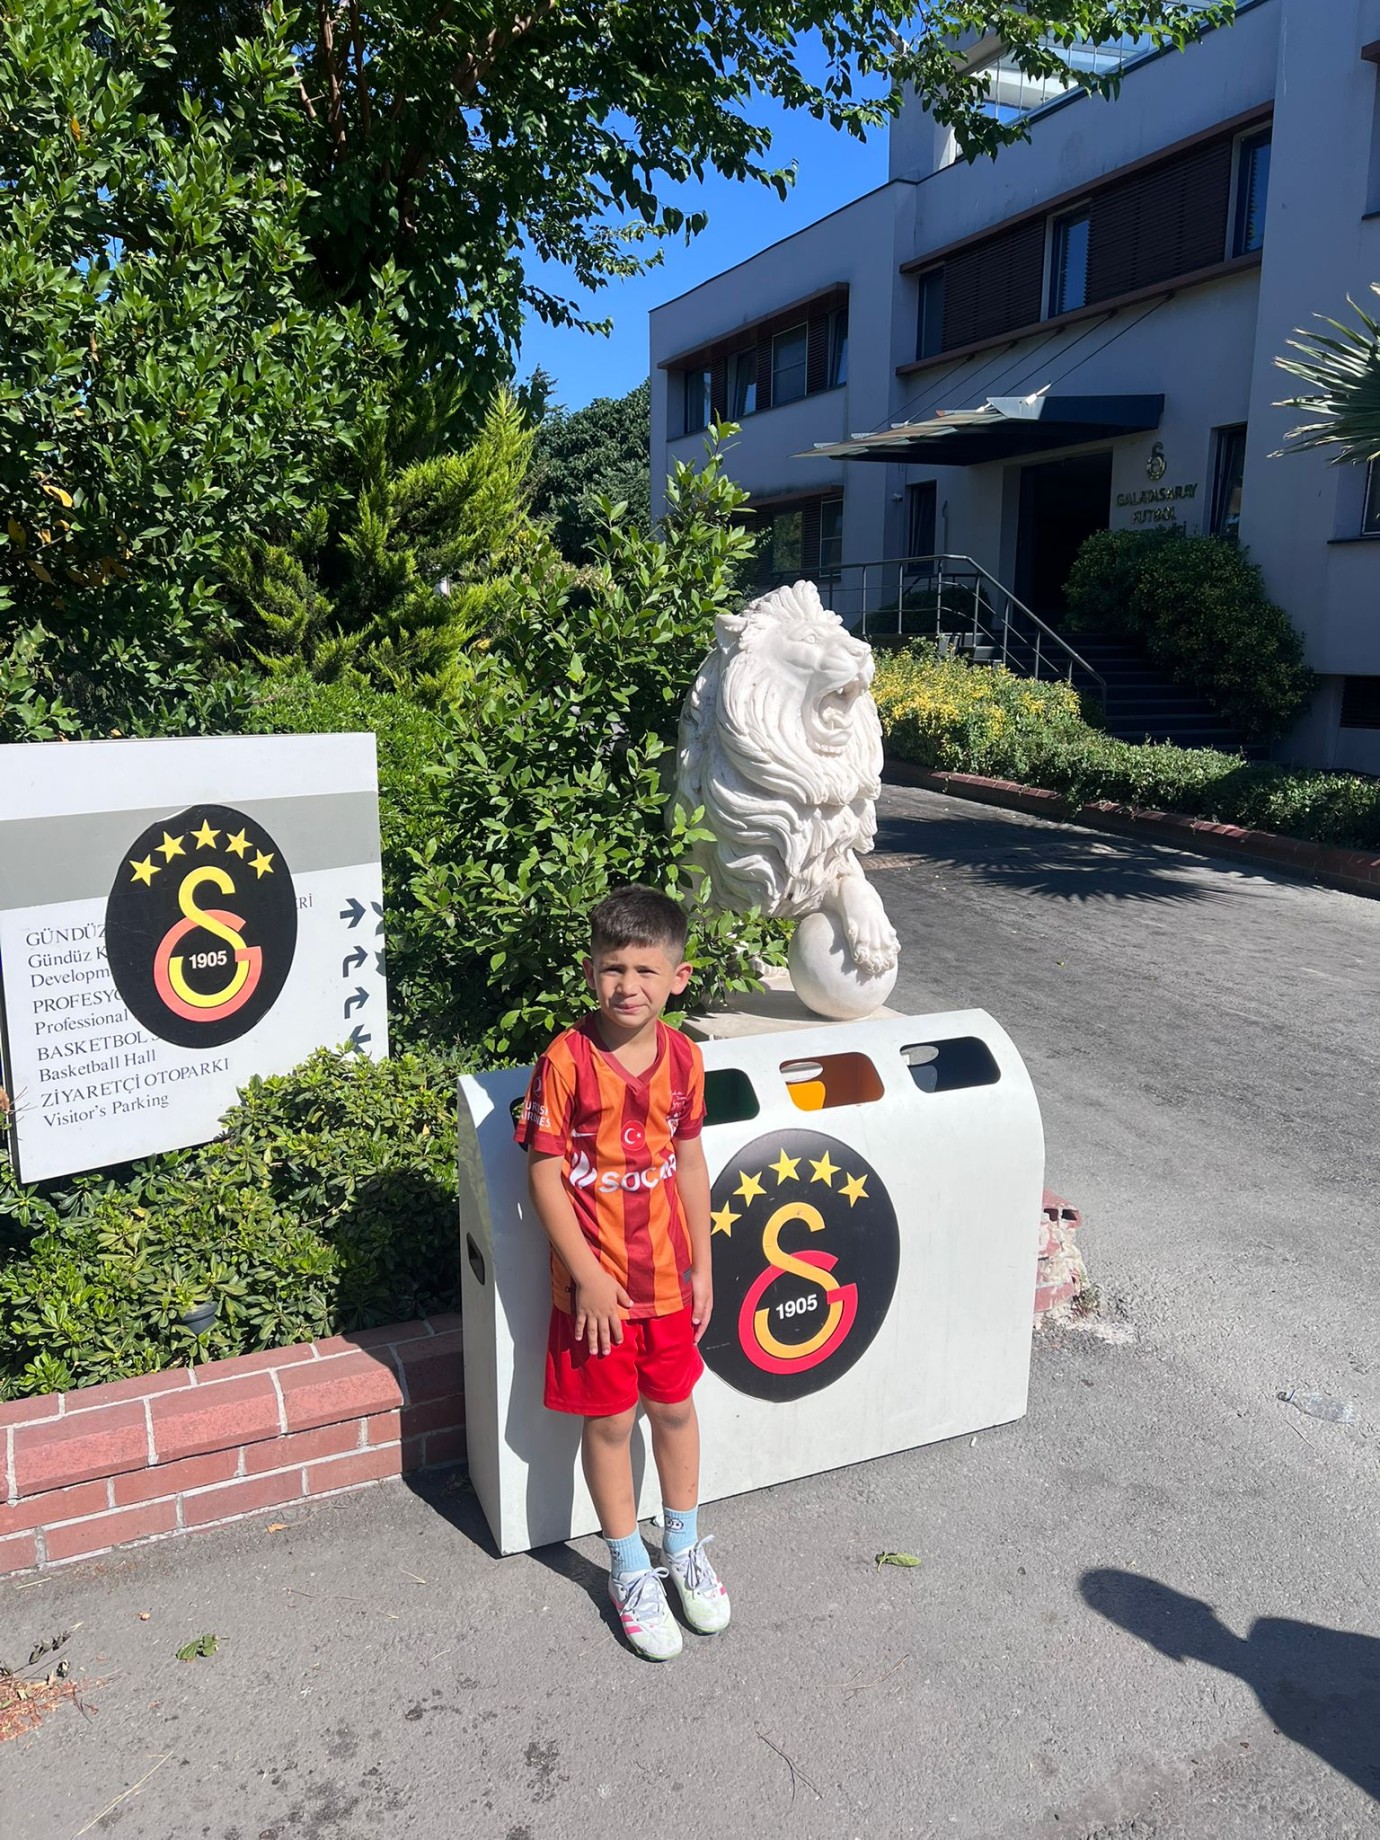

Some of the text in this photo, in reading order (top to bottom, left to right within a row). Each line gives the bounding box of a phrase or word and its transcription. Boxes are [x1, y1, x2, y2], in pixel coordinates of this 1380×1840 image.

[26, 923, 106, 947] GÜNDÜZ
[28, 950, 92, 969] Gündüz
[188, 950, 228, 969] 1905
[30, 968, 110, 988] Developm
[34, 1008, 128, 1036] Professional
[37, 1031, 148, 1061] BASKETBOL
[39, 1049, 157, 1083] Basketball Hall
[41, 1057, 230, 1108] ZİYARETÇİ OTOPARKI
[43, 1094, 170, 1127] Visitor's Parking
[775, 1294, 818, 1320] 1905
